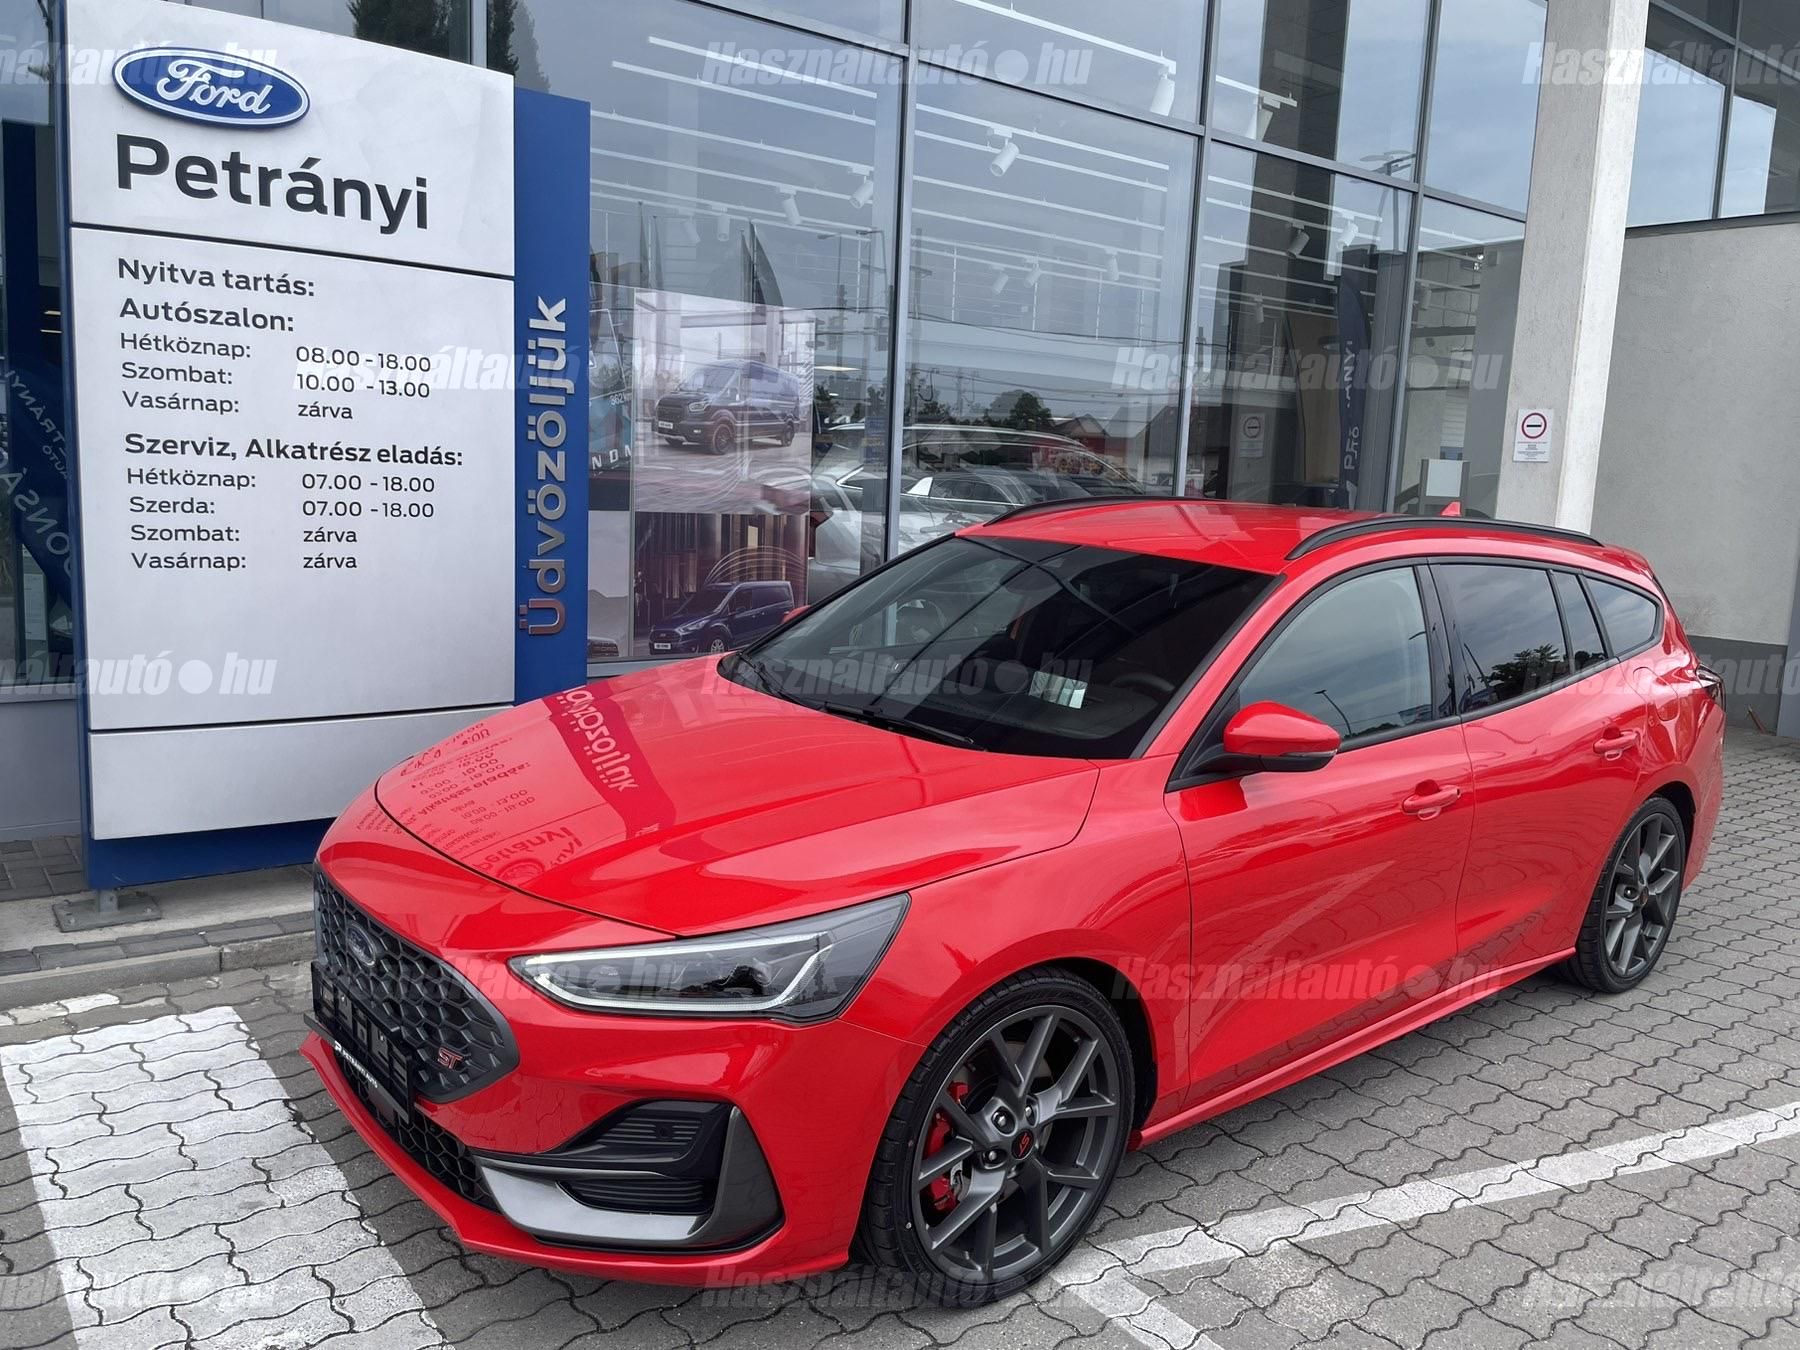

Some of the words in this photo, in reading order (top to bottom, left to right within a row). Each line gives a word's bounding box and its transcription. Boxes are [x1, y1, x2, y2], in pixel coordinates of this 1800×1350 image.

[156, 58, 273, 115] Ford
[116, 133, 428, 235] Petrányi
[118, 257, 216, 288] Nyitva
[221, 269, 315, 297] tartás:
[119, 297, 294, 332] Autószalon:
[120, 332, 251, 360] Hétköznap:
[296, 346, 360, 366] 08.00
[121, 361, 233, 385] Szombat:
[296, 373, 355, 393] 10.00
[122, 390, 239, 416] Vasárnap:
[297, 401, 353, 420] zárva
[125, 433, 237, 461] Szerviz,
[245, 438, 372, 463] Alkatrész
[376, 444, 463, 466] eladás:
[519, 295, 575, 637] Üdvözöljük
[127, 467, 256, 491] Hétköznap:
[302, 473, 362, 491] 07.00
[129, 496, 215, 514] Szerda:
[302, 500, 362, 517] 07.00
[130, 524, 240, 542] Szombat:
[303, 526, 358, 543] zárva
[131, 551, 246, 572] Vasárnap:
[303, 552, 358, 569] zárva
[437, 1046, 464, 1070] ST
